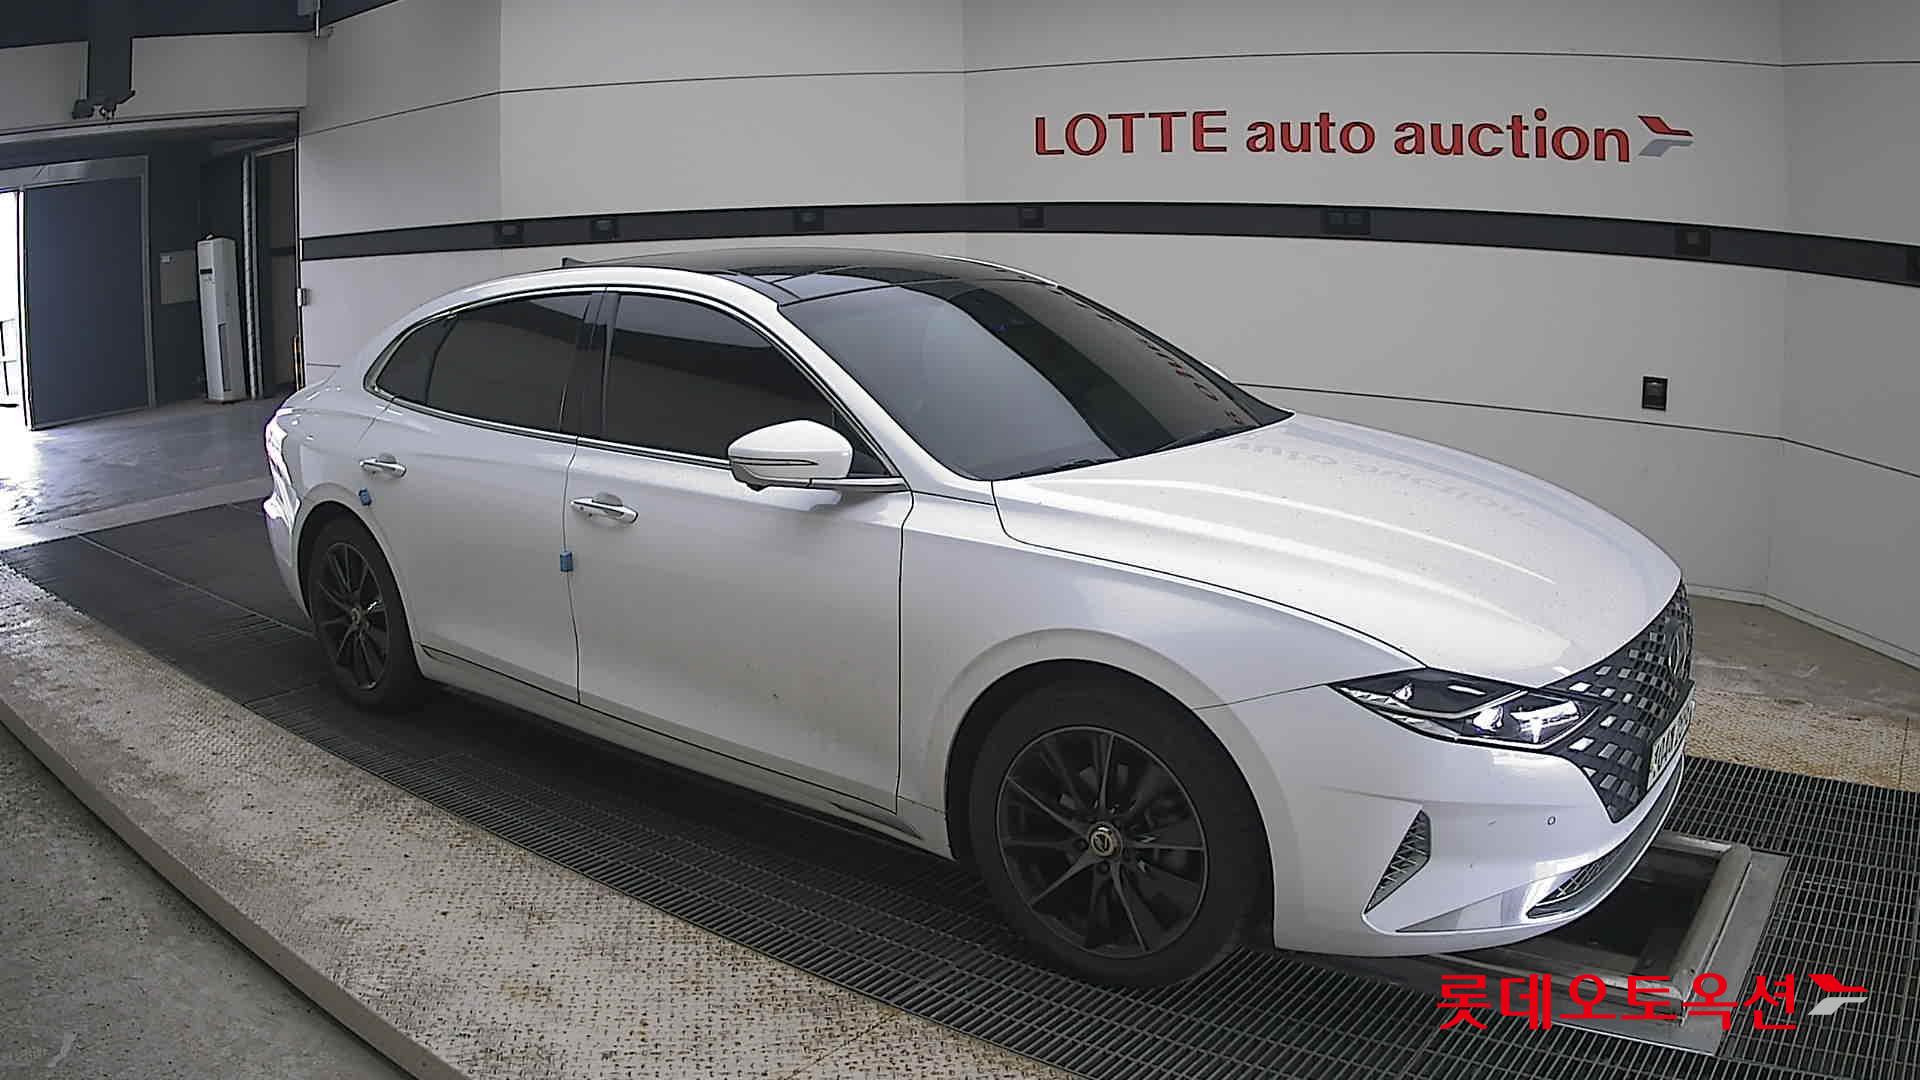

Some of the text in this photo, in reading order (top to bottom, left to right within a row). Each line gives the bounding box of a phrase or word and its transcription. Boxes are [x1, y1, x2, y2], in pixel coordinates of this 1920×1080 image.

[1034, 107, 1631, 163] LOTTE auto auction
